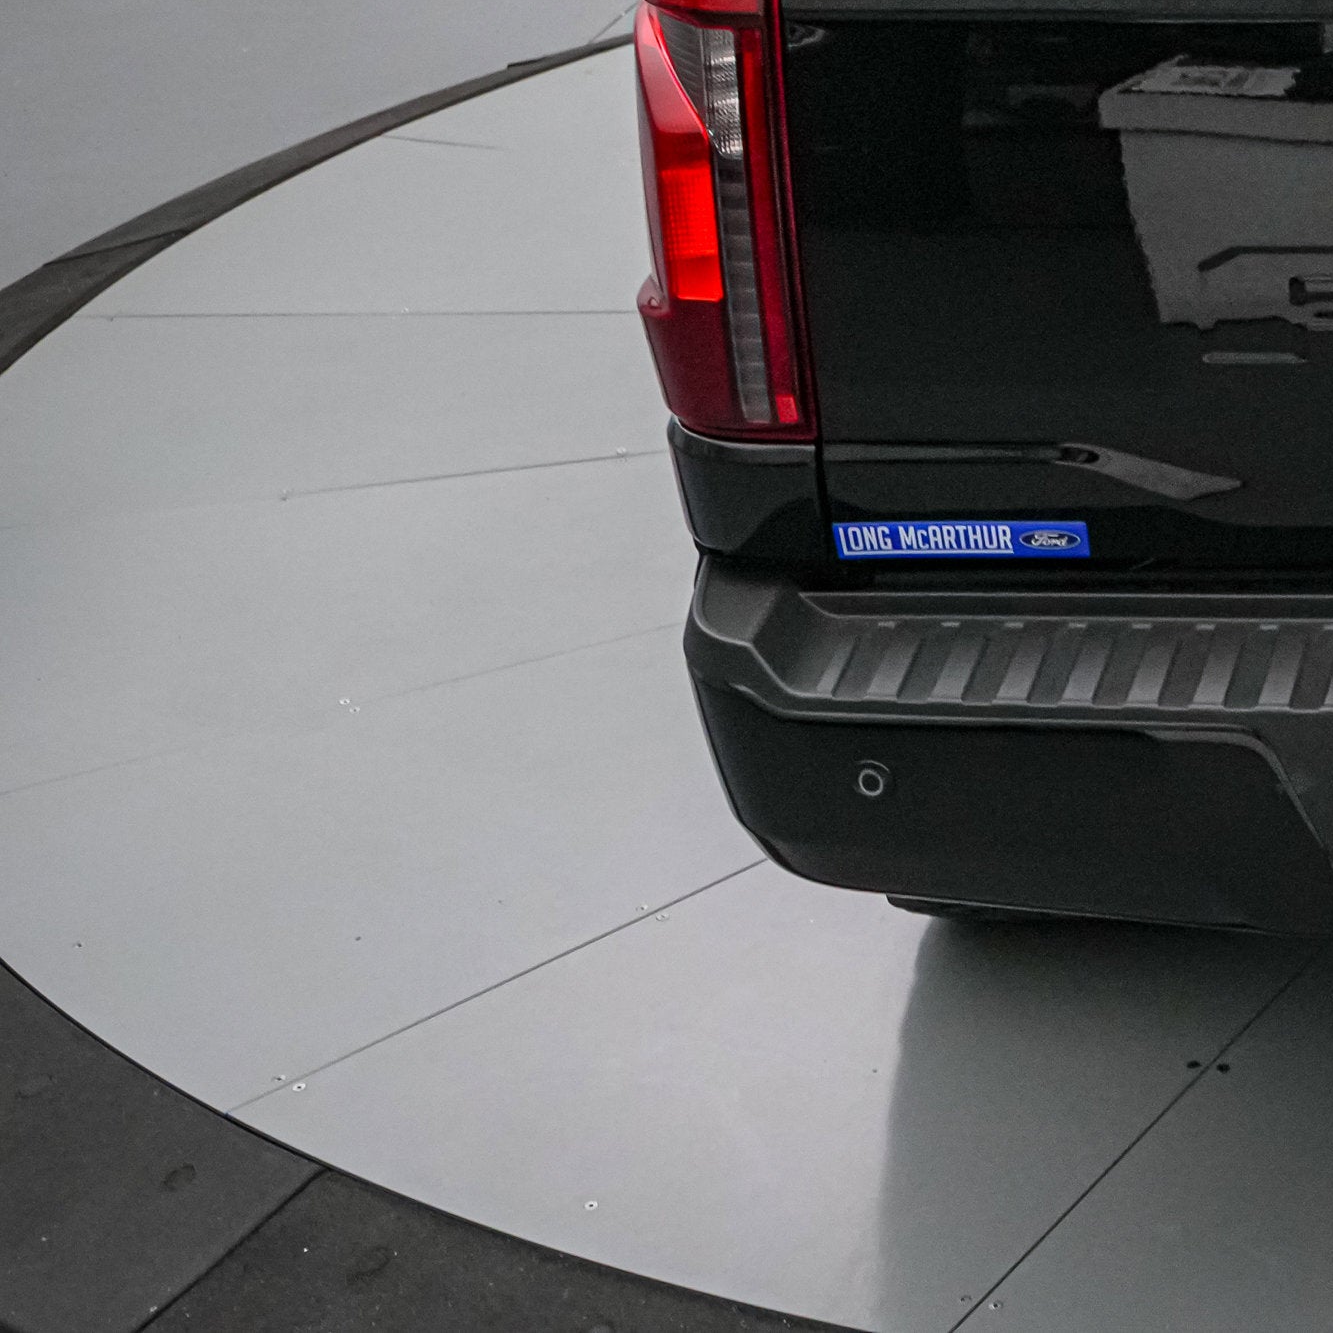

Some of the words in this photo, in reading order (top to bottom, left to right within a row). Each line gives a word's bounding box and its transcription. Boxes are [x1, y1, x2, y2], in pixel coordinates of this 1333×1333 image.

[837, 525, 894, 555] LONG
[898, 524, 1014, 550] McARTHUR
[1030, 532, 1069, 547] Ford
